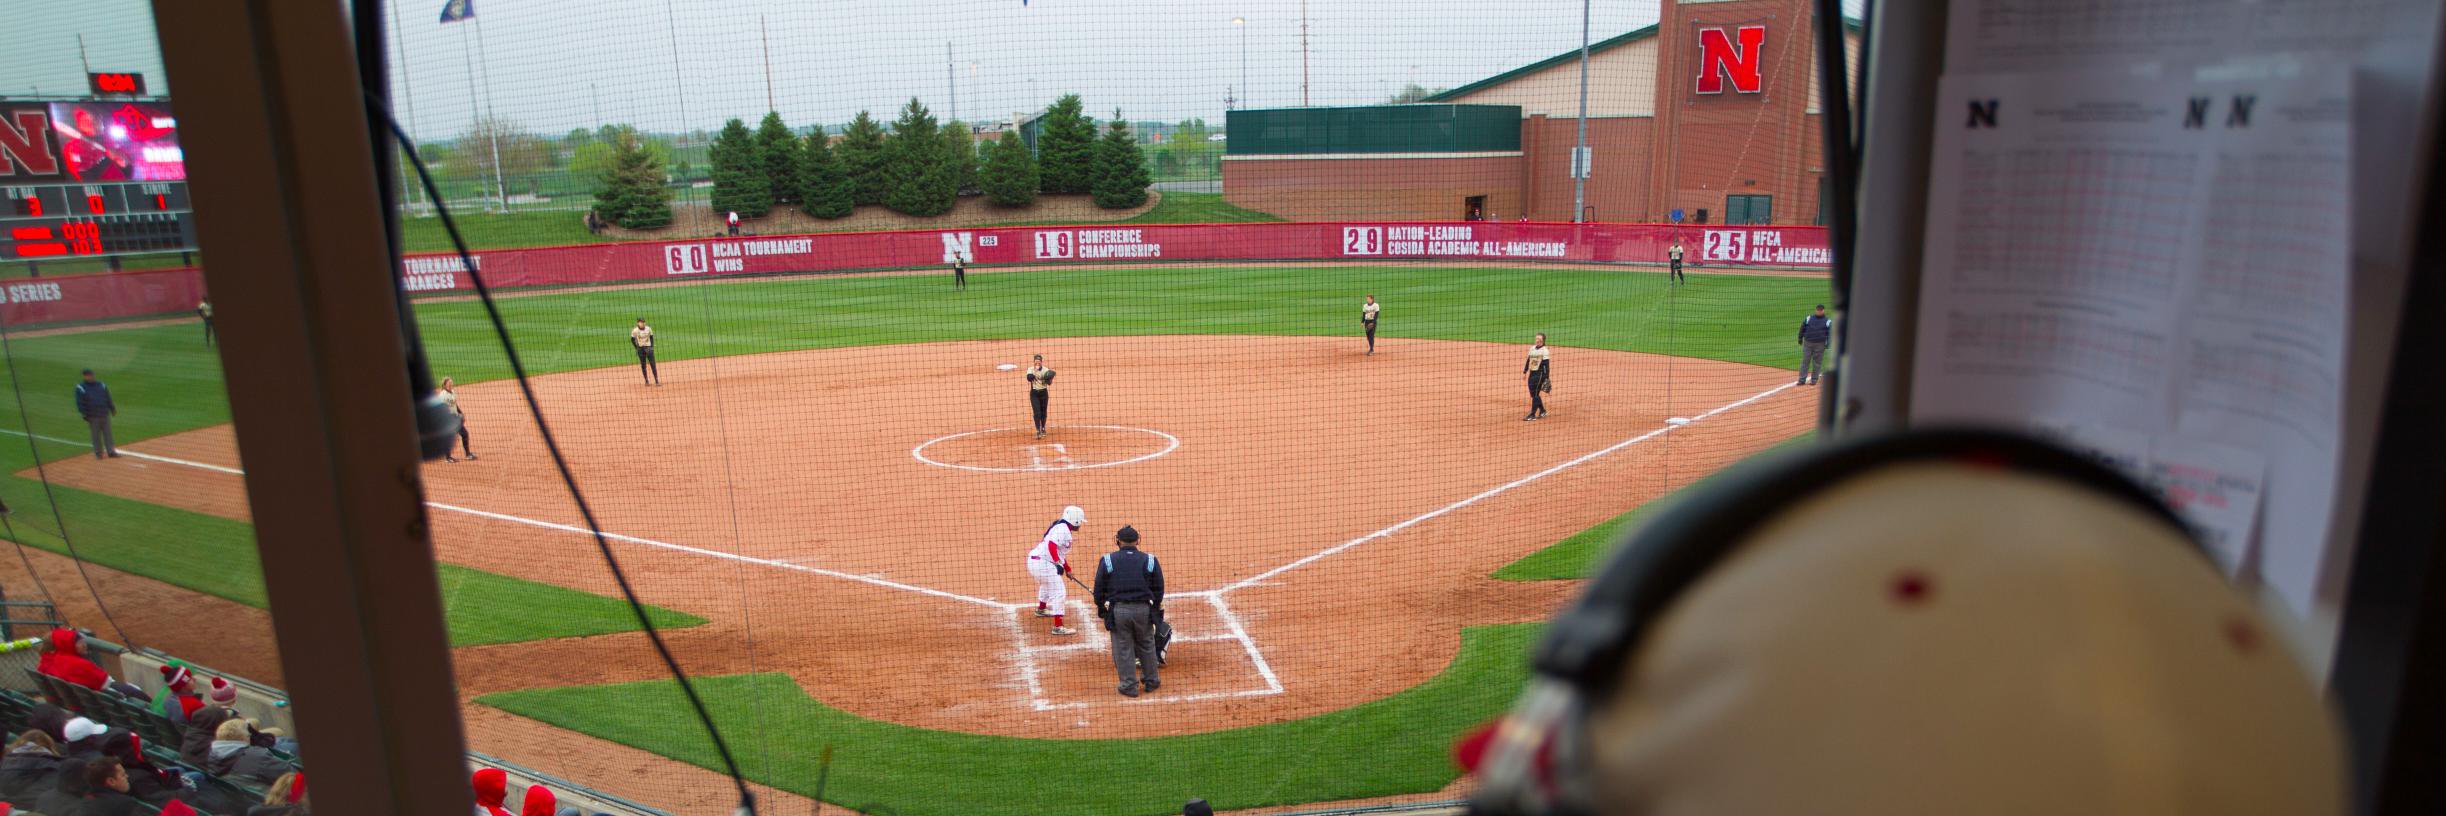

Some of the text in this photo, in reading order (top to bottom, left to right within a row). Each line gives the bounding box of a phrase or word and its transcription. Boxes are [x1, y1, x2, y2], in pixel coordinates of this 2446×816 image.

[1696, 26, 1765, 94] N
[0, 110, 59, 175] N
[1078, 229, 1142, 244] CONFERENCE
[1347, 228, 1379, 253] 29
[1388, 226, 1472, 241] NATION-LEADING
[1752, 230, 1781, 246] NFCA
[711, 239, 813, 257] NCAA TOURNAMENT
[941, 232, 974, 264] N
[1039, 232, 1069, 257] 19
[1079, 243, 1161, 258] CHAMPIONSHIPS
[1388, 241, 1565, 257] COSIDA ACADEMIC ALL-AMERICANS
[1707, 232, 1742, 259] 25
[404, 255, 480, 275] TOURNAMET
[669, 246, 704, 272] 60
[713, 258, 744, 273] WINS
[9, 283, 62, 303] SERIES
